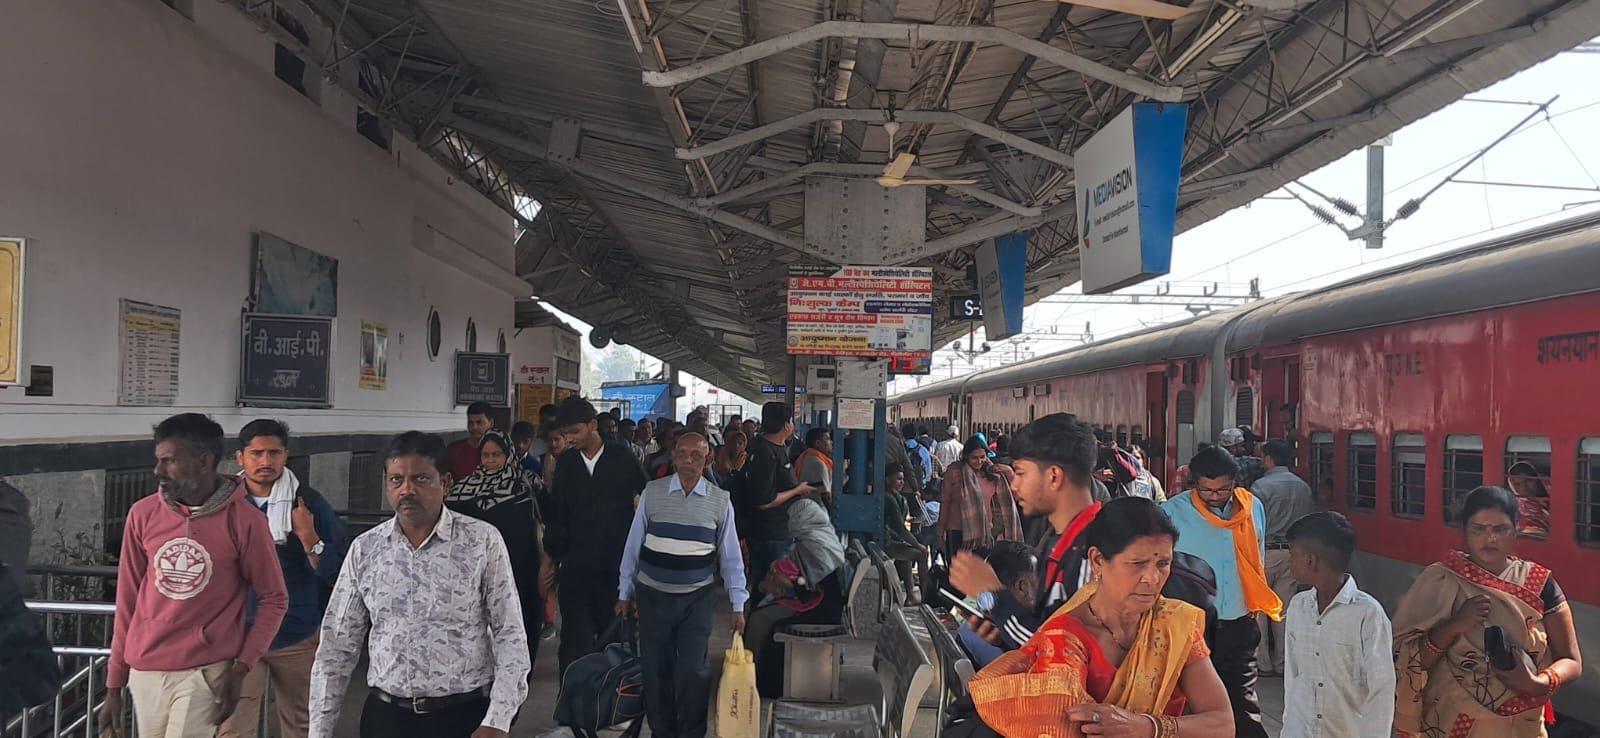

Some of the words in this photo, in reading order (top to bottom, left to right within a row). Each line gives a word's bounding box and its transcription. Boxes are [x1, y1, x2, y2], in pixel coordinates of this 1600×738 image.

[1093, 165, 1133, 208] MEDIAVISION
[253, 327, 325, 359] वी.आई.पी.
[165, 544, 203, 561] ADIDAS
